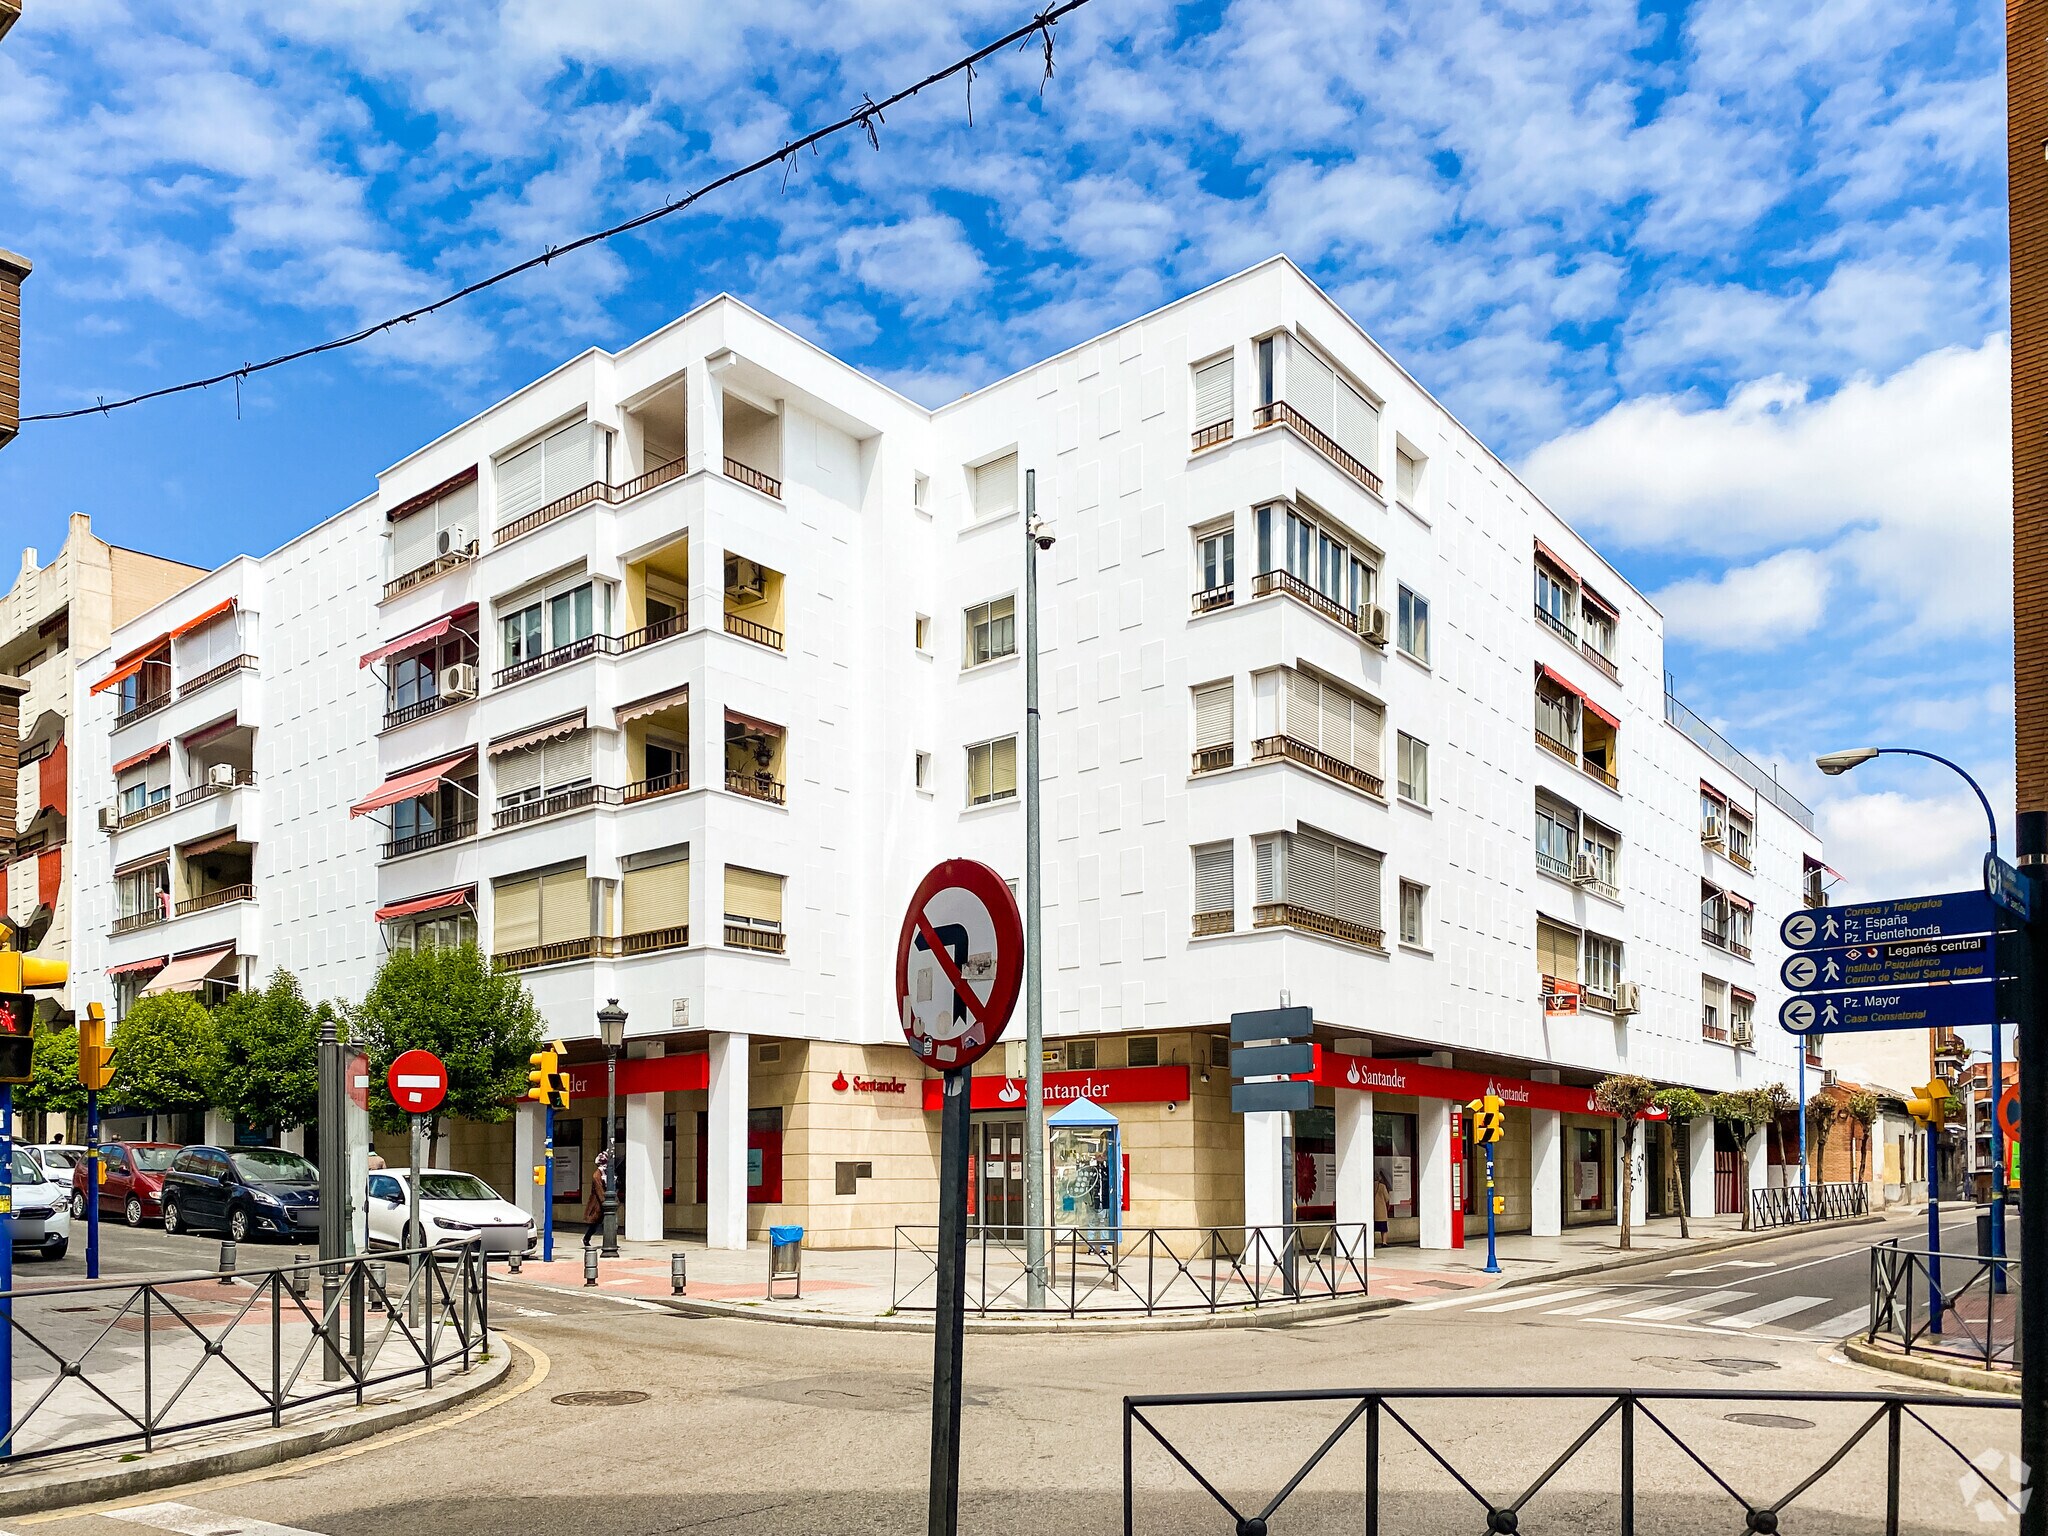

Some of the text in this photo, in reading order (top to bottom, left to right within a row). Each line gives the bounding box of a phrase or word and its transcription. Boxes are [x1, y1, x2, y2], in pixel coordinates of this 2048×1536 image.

[1845, 907, 1882, 917] Correos
[1884, 905, 1890, 914] y
[1844, 914, 1908, 930] Pz. España
[1844, 924, 1941, 943] Pz. Fuentehonda
[1888, 939, 1981, 957] Leganés central
[1845, 959, 1941, 973] Instituto Psiquiátrico
[1845, 965, 1984, 985] Centro de Salud Santa Isabel
[1843, 995, 1901, 1008] Pz. Mayor
[1844, 1009, 1927, 1024] Casa Consistorial
[853, 1075, 907, 1094] Santander
[1361, 1064, 1406, 1089] Santander
[1024, 1077, 1110, 1100] ntander
